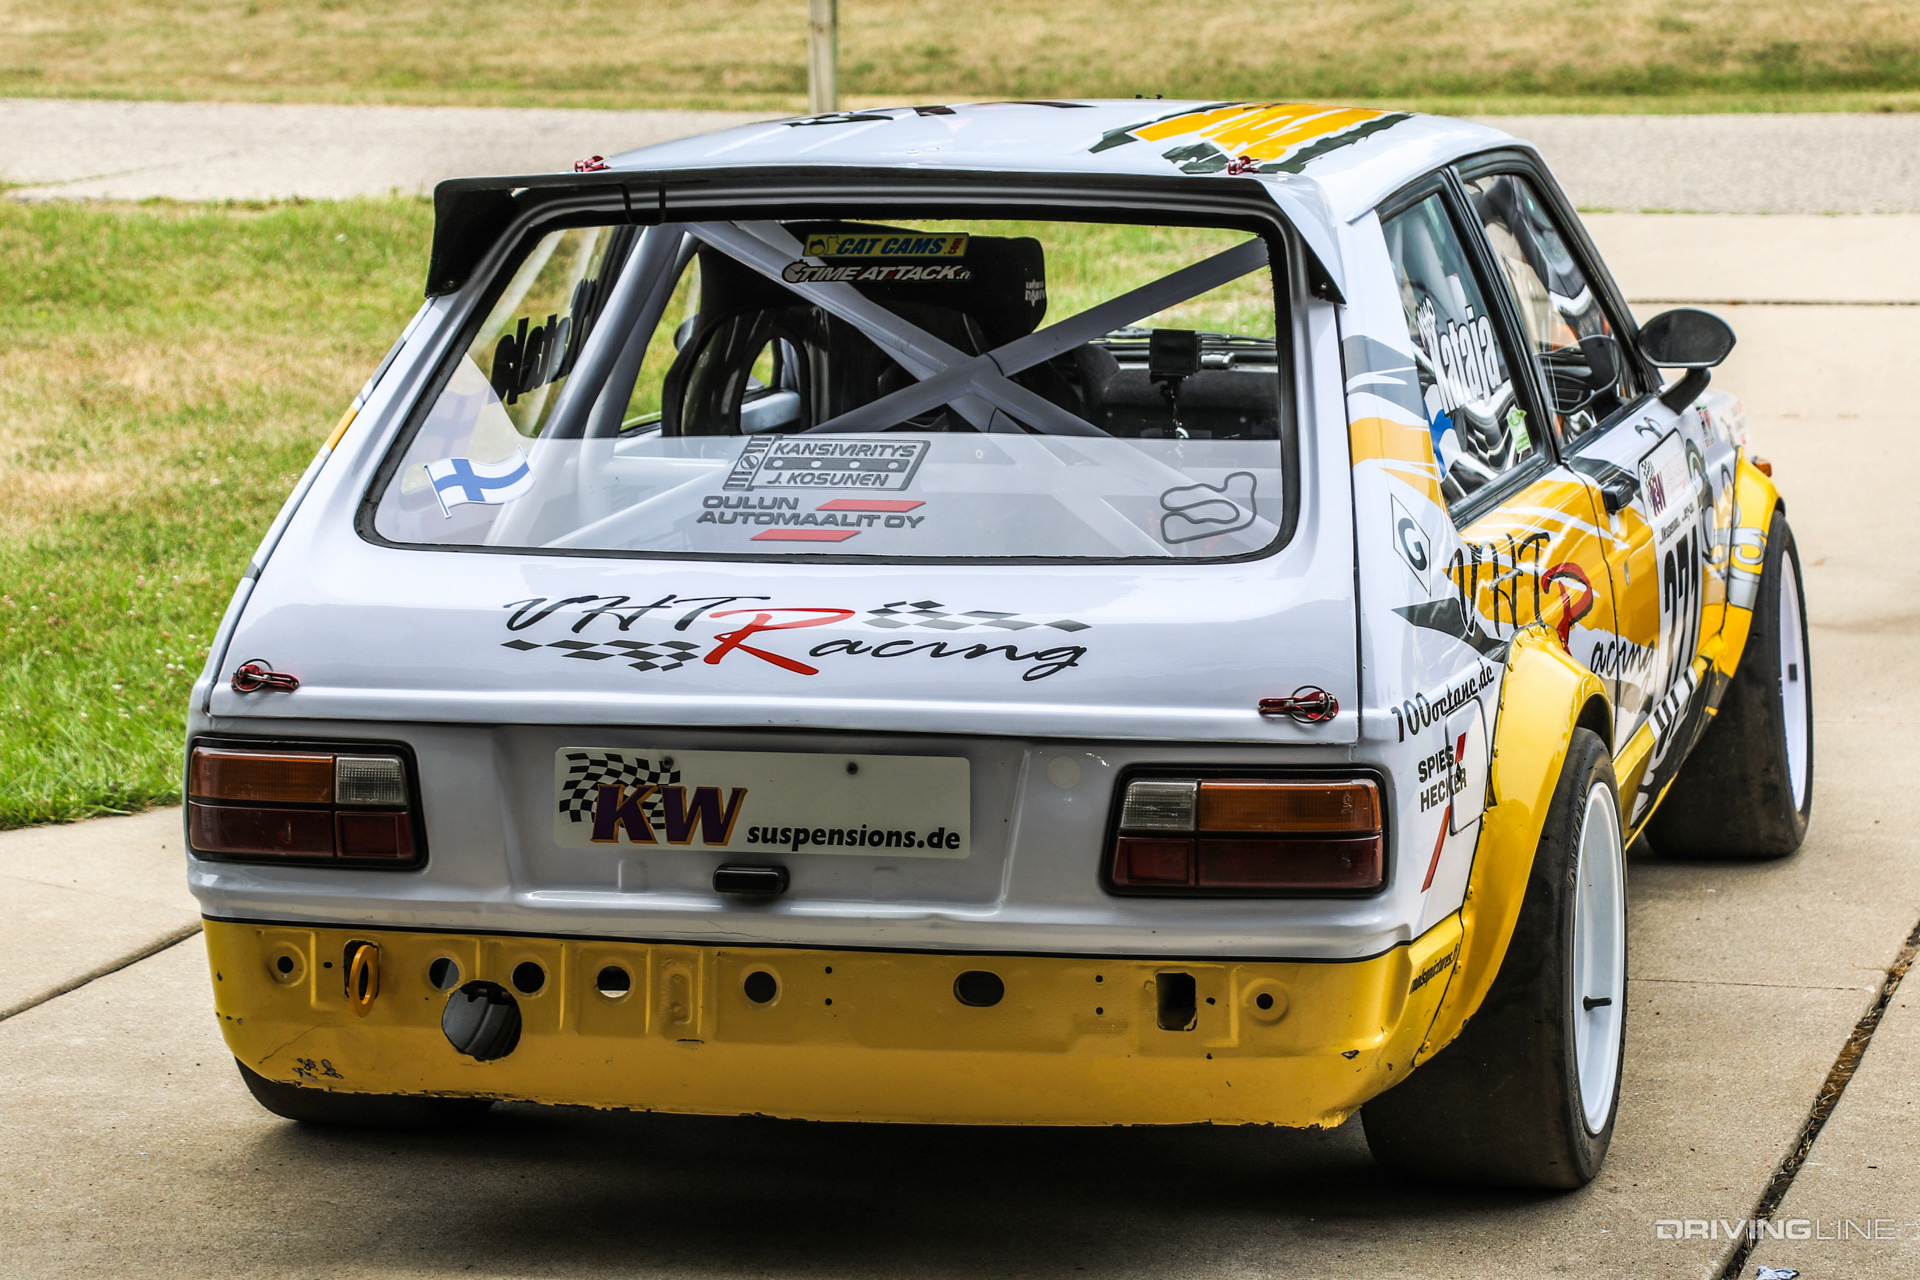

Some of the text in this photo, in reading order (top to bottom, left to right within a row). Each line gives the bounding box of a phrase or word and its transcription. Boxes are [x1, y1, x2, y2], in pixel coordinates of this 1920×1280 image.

[836, 237, 881, 255] CAT
[880, 237, 947, 255] CAMS
[773, 442, 918, 458] KANSIVIRITYS
[766, 471, 890, 487] J. KOSUNEN
[701, 495, 800, 511] OULUN
[696, 511, 926, 529] AUTOMAALIT OY
[1397, 517, 1429, 572] G
[503, 594, 1090, 682] VHT Racing
[1417, 745, 1455, 784] SPIES
[1419, 766, 1467, 813] HECKER
[590, 783, 961, 852] KW suspensions.de
